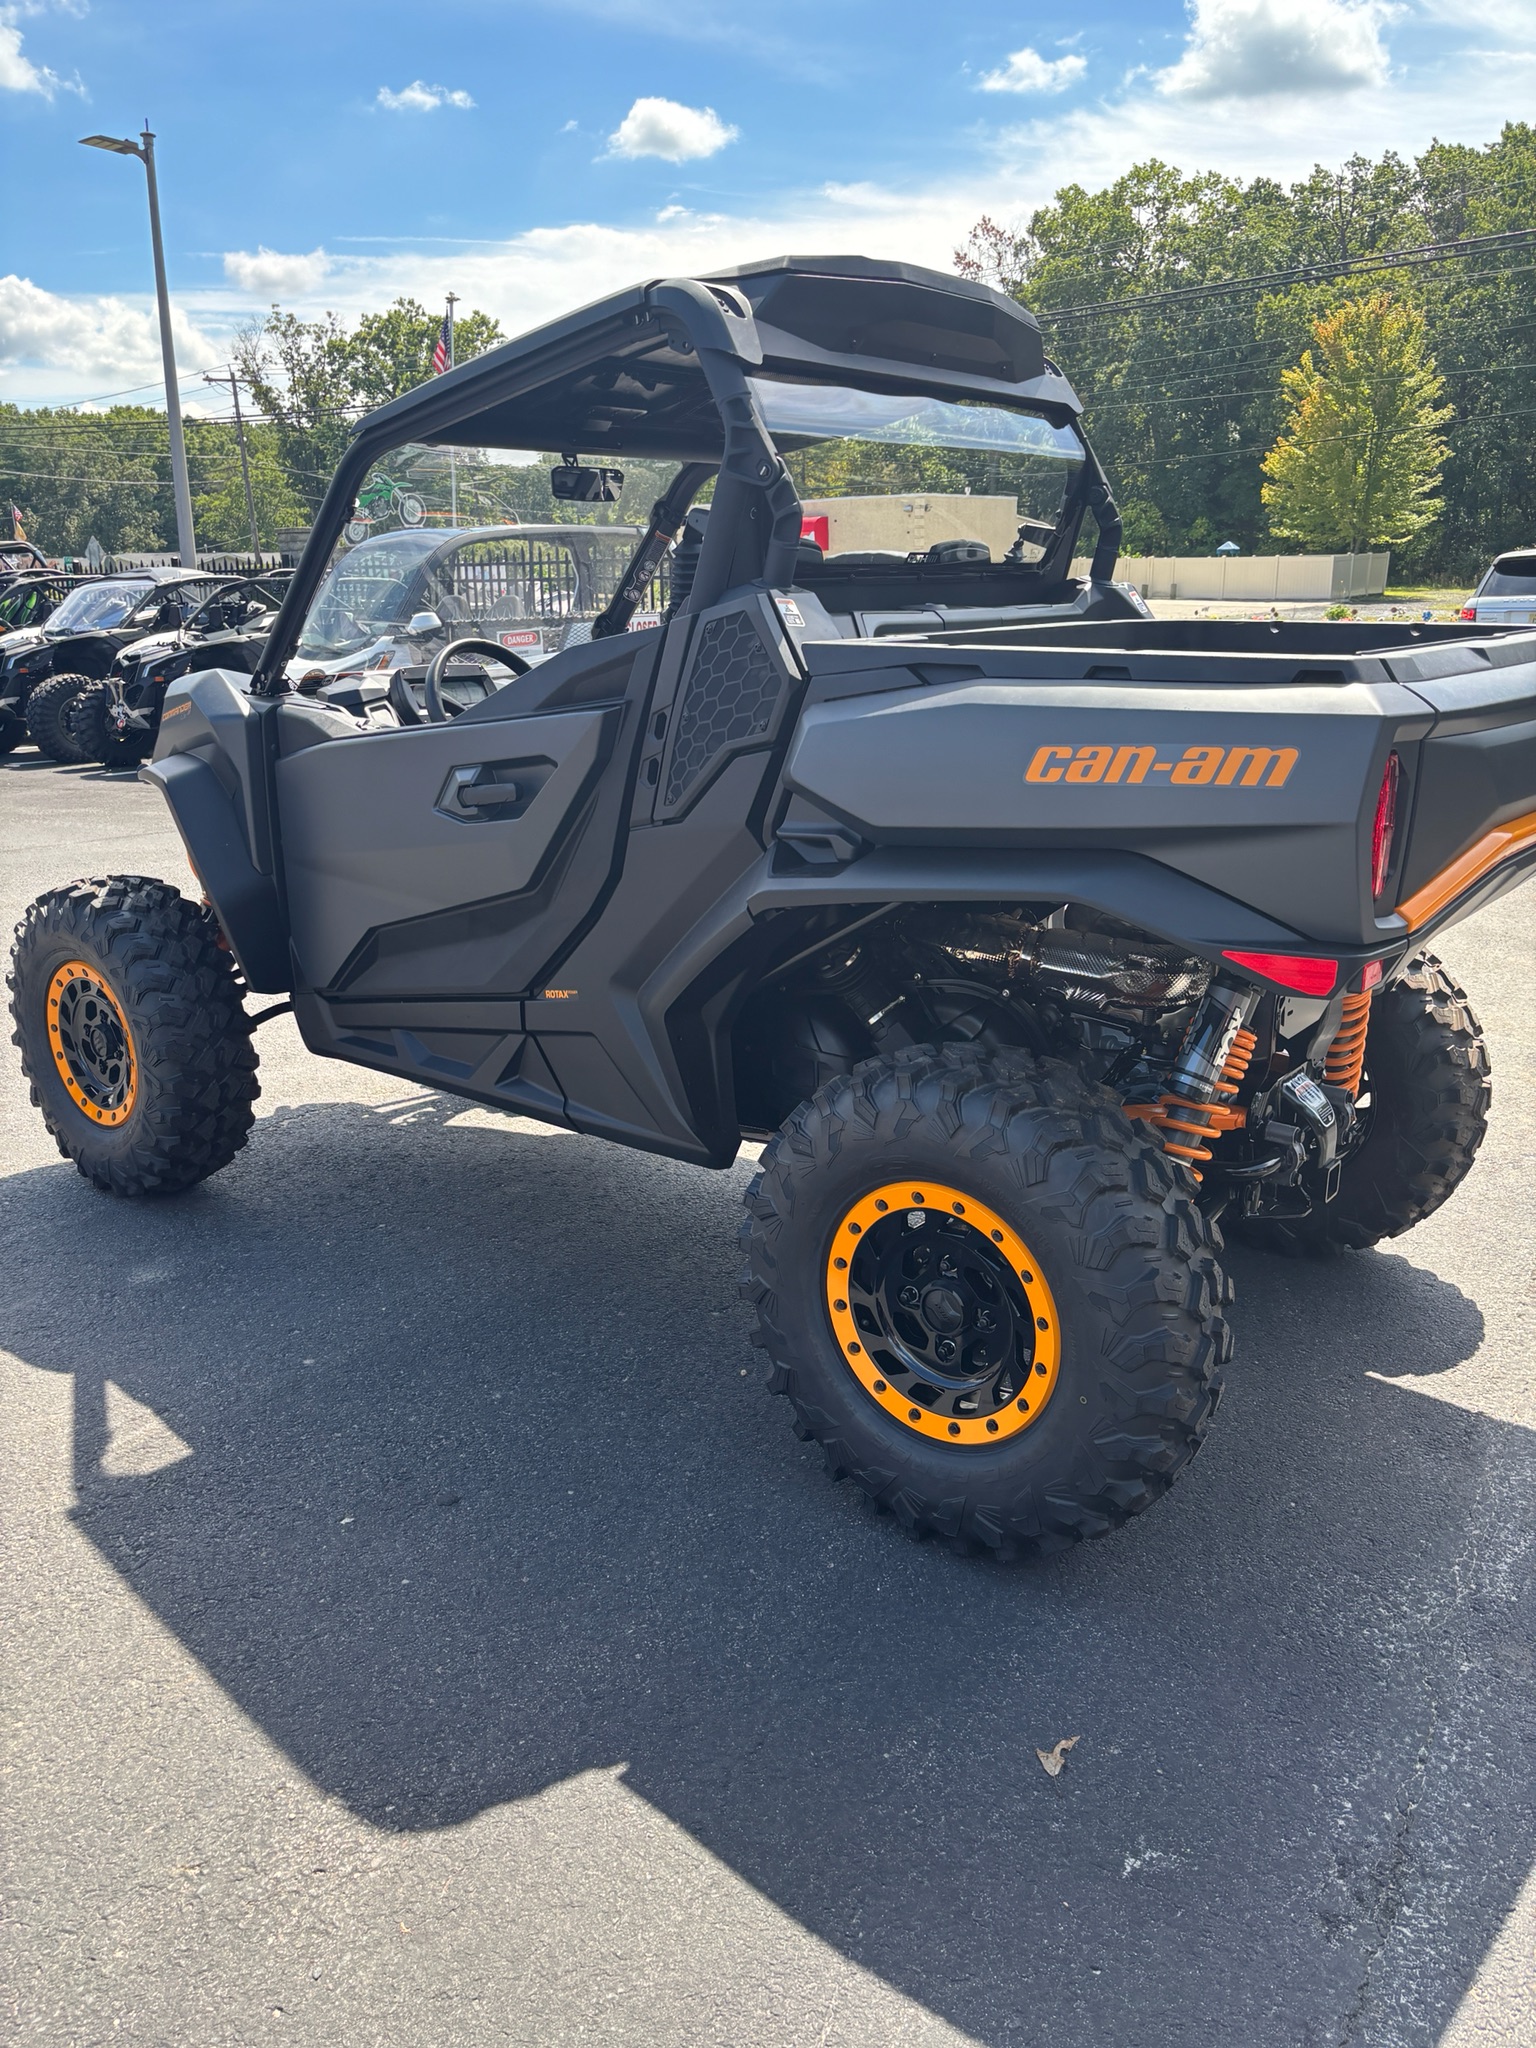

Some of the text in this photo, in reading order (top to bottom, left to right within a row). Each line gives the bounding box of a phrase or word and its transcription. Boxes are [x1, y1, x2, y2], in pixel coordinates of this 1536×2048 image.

[507, 634, 534, 645] DANGER
[1024, 746, 1299, 787] can-am
[545, 989, 569, 999] ROTAX
[1213, 1006, 1244, 1067] FOX
